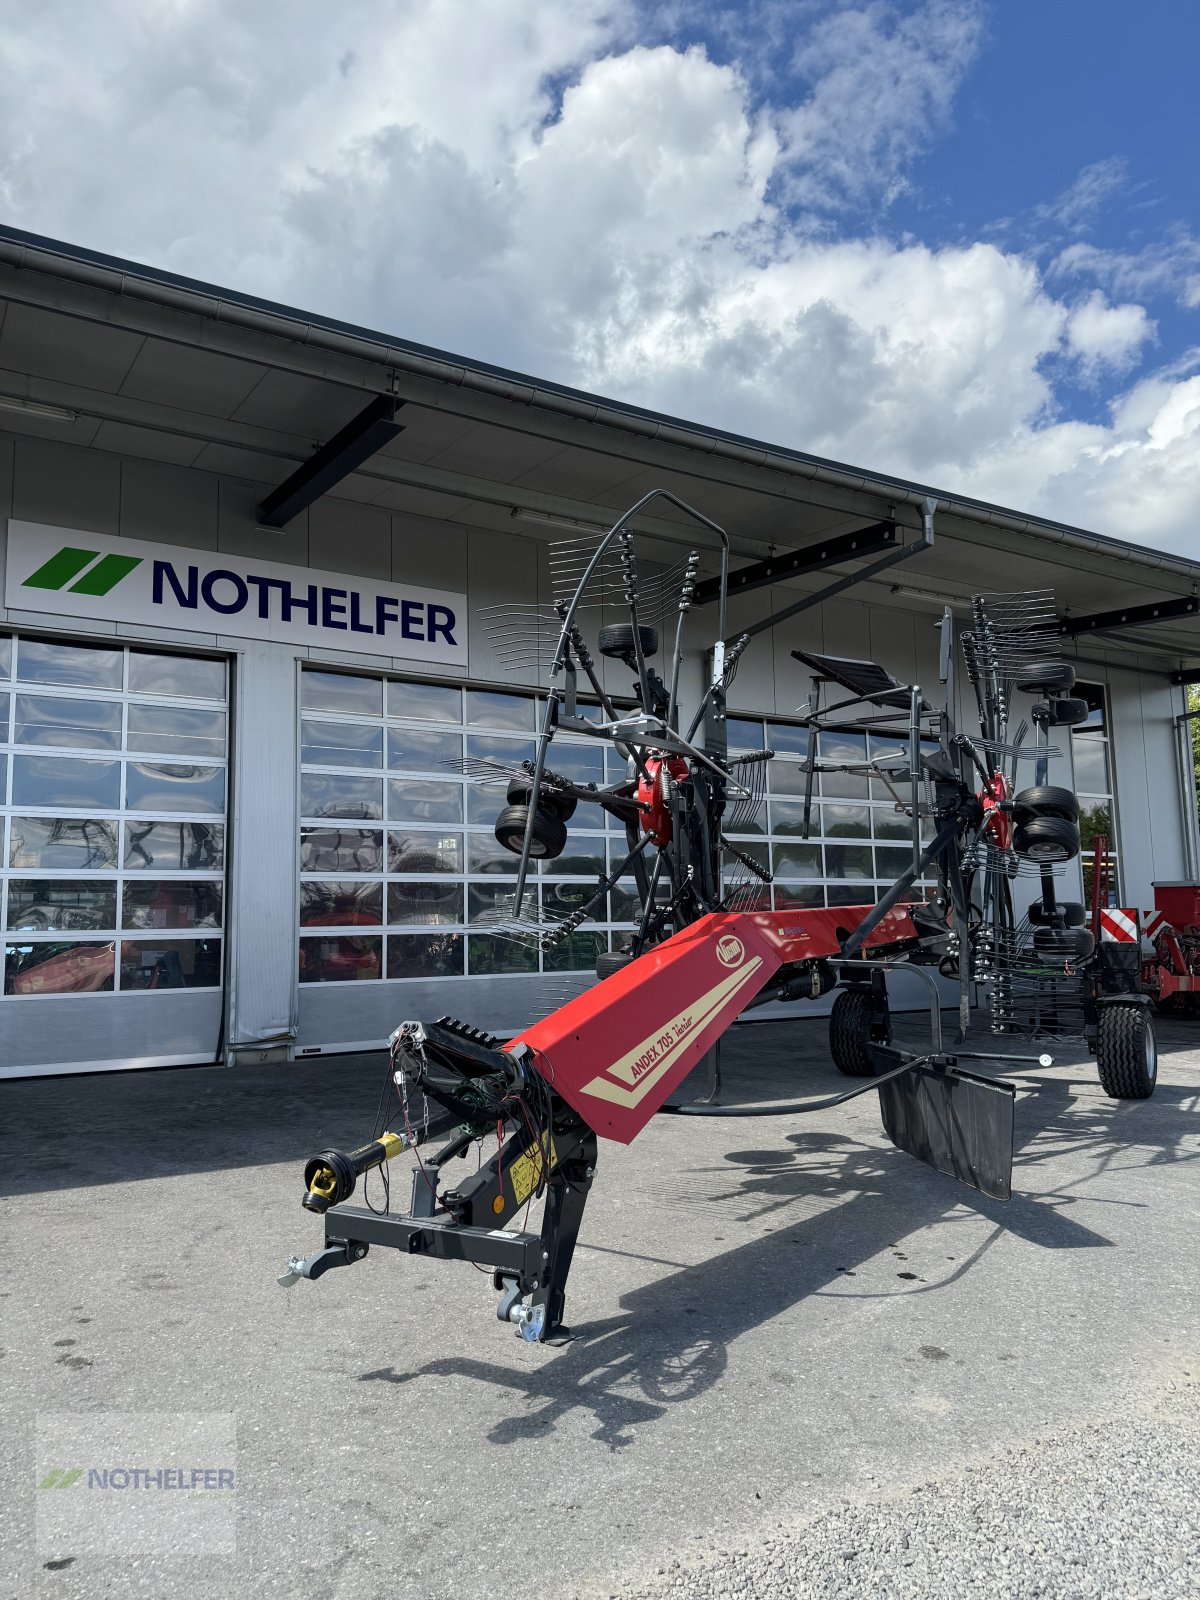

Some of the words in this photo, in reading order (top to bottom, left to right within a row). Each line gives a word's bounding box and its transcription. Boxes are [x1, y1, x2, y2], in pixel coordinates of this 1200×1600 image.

[152, 560, 458, 646] NOTHELFER
[630, 1045, 660, 1080] ANDEX
[656, 1032, 674, 1052] 705
[671, 1016, 693, 1038] Vario
